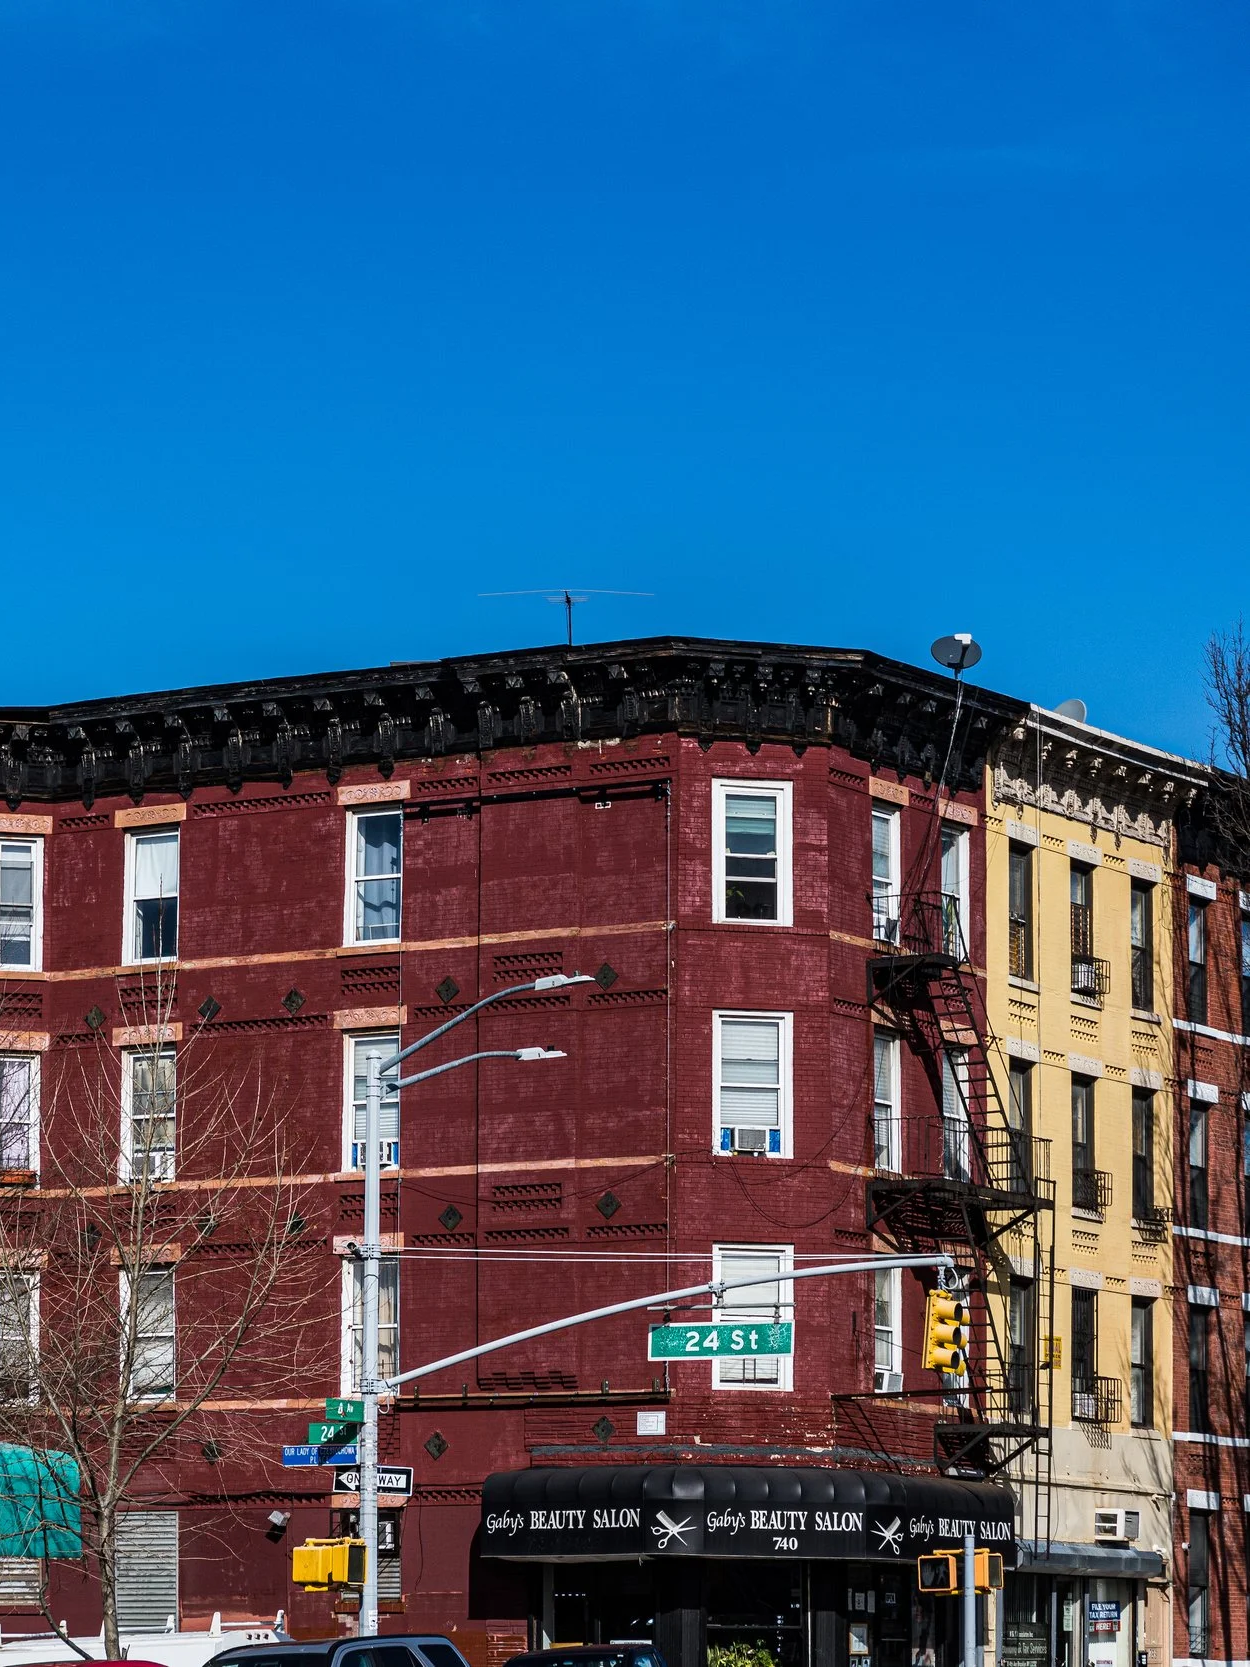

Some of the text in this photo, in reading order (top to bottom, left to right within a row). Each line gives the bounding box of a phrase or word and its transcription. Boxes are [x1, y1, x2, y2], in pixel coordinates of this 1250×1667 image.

[685, 1329, 759, 1352] 24 St
[320, 1425, 348, 1441] 24 St
[284, 1447, 295, 1456] OUR
[296, 1447, 310, 1457] LADY
[311, 1447, 319, 1456] OF
[378, 1474, 402, 1487] WAY
[486, 1508, 640, 1536] Gaby's BEAUTY SALON
[707, 1508, 863, 1535] Gaby's BEAUTY SALON
[909, 1515, 1011, 1542] Gaby's BEAUTY SALON
[772, 1537, 798, 1550] 740
[1103, 1603, 1116, 1611] YOUR
[1089, 1611, 1118, 1619] TAX RETURN
